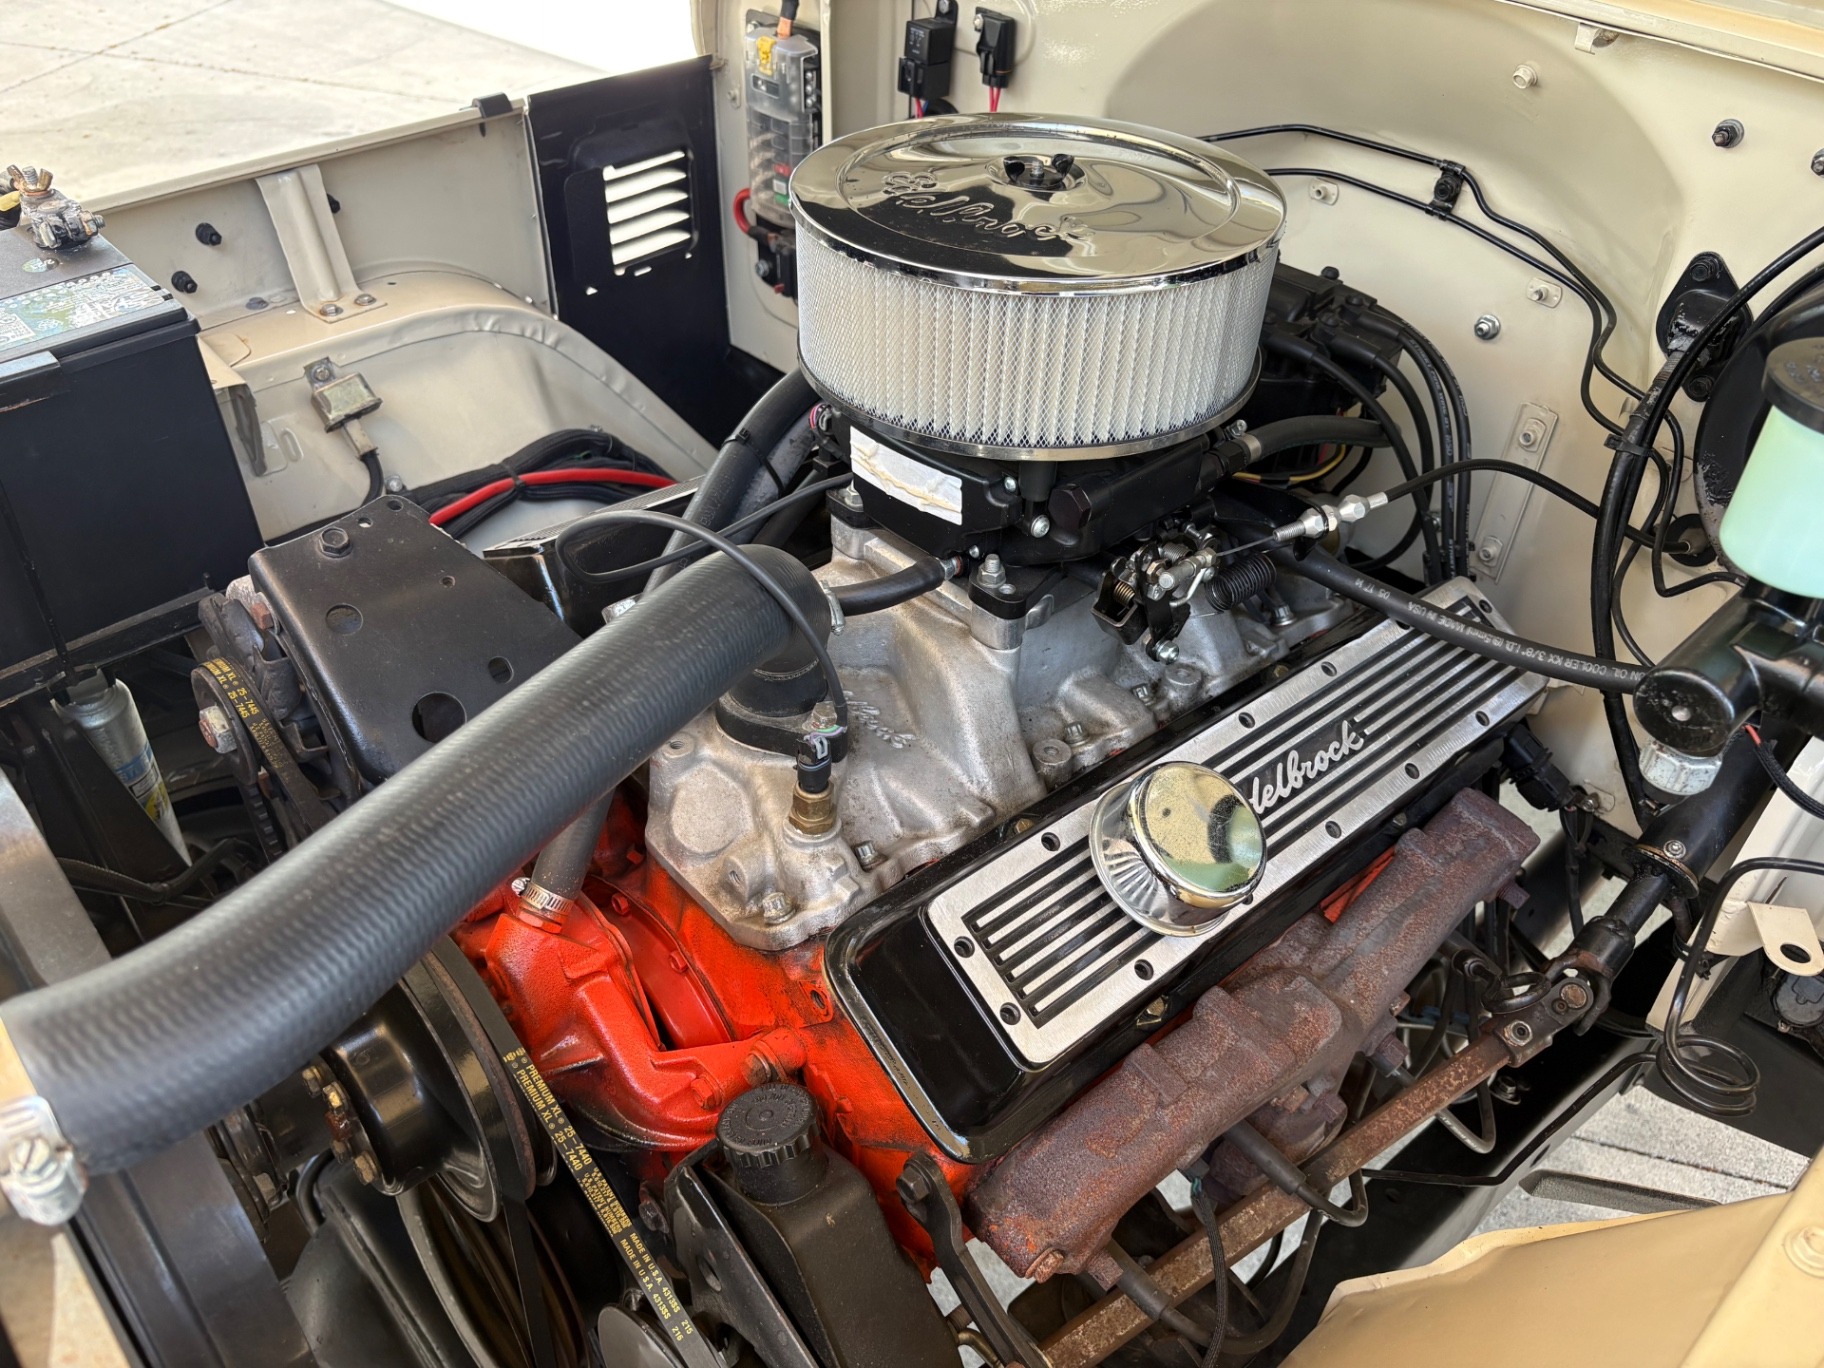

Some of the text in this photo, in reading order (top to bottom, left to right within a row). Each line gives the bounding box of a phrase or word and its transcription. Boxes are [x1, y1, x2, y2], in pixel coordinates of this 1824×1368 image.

[1405, 602, 1426, 617] USA
[1426, 611, 1437, 621] IN
[1437, 615, 1465, 633] MADE
[1547, 654, 1563, 665] KX
[1564, 658, 1607, 676] COOLER
[1610, 668, 1628, 679] OIL
[1248, 719, 1364, 815] delbrock
[517, 1069, 546, 1110] PREMIUM
[554, 1131, 583, 1171] 25-7440
[526, 1064, 555, 1105] PREMIUM
[564, 1125, 592, 1165] 25-7440
[620, 1239, 636, 1260] MADE
[633, 1260, 641, 1269] IN
[639, 1269, 653, 1292] U.S.A.
[672, 1326, 684, 1341] 216
[630, 1233, 645, 1254] MADE
[642, 1254, 651, 1263] IN
[648, 1263, 663, 1286] U.S.A.
[681, 1319, 693, 1334] 215
